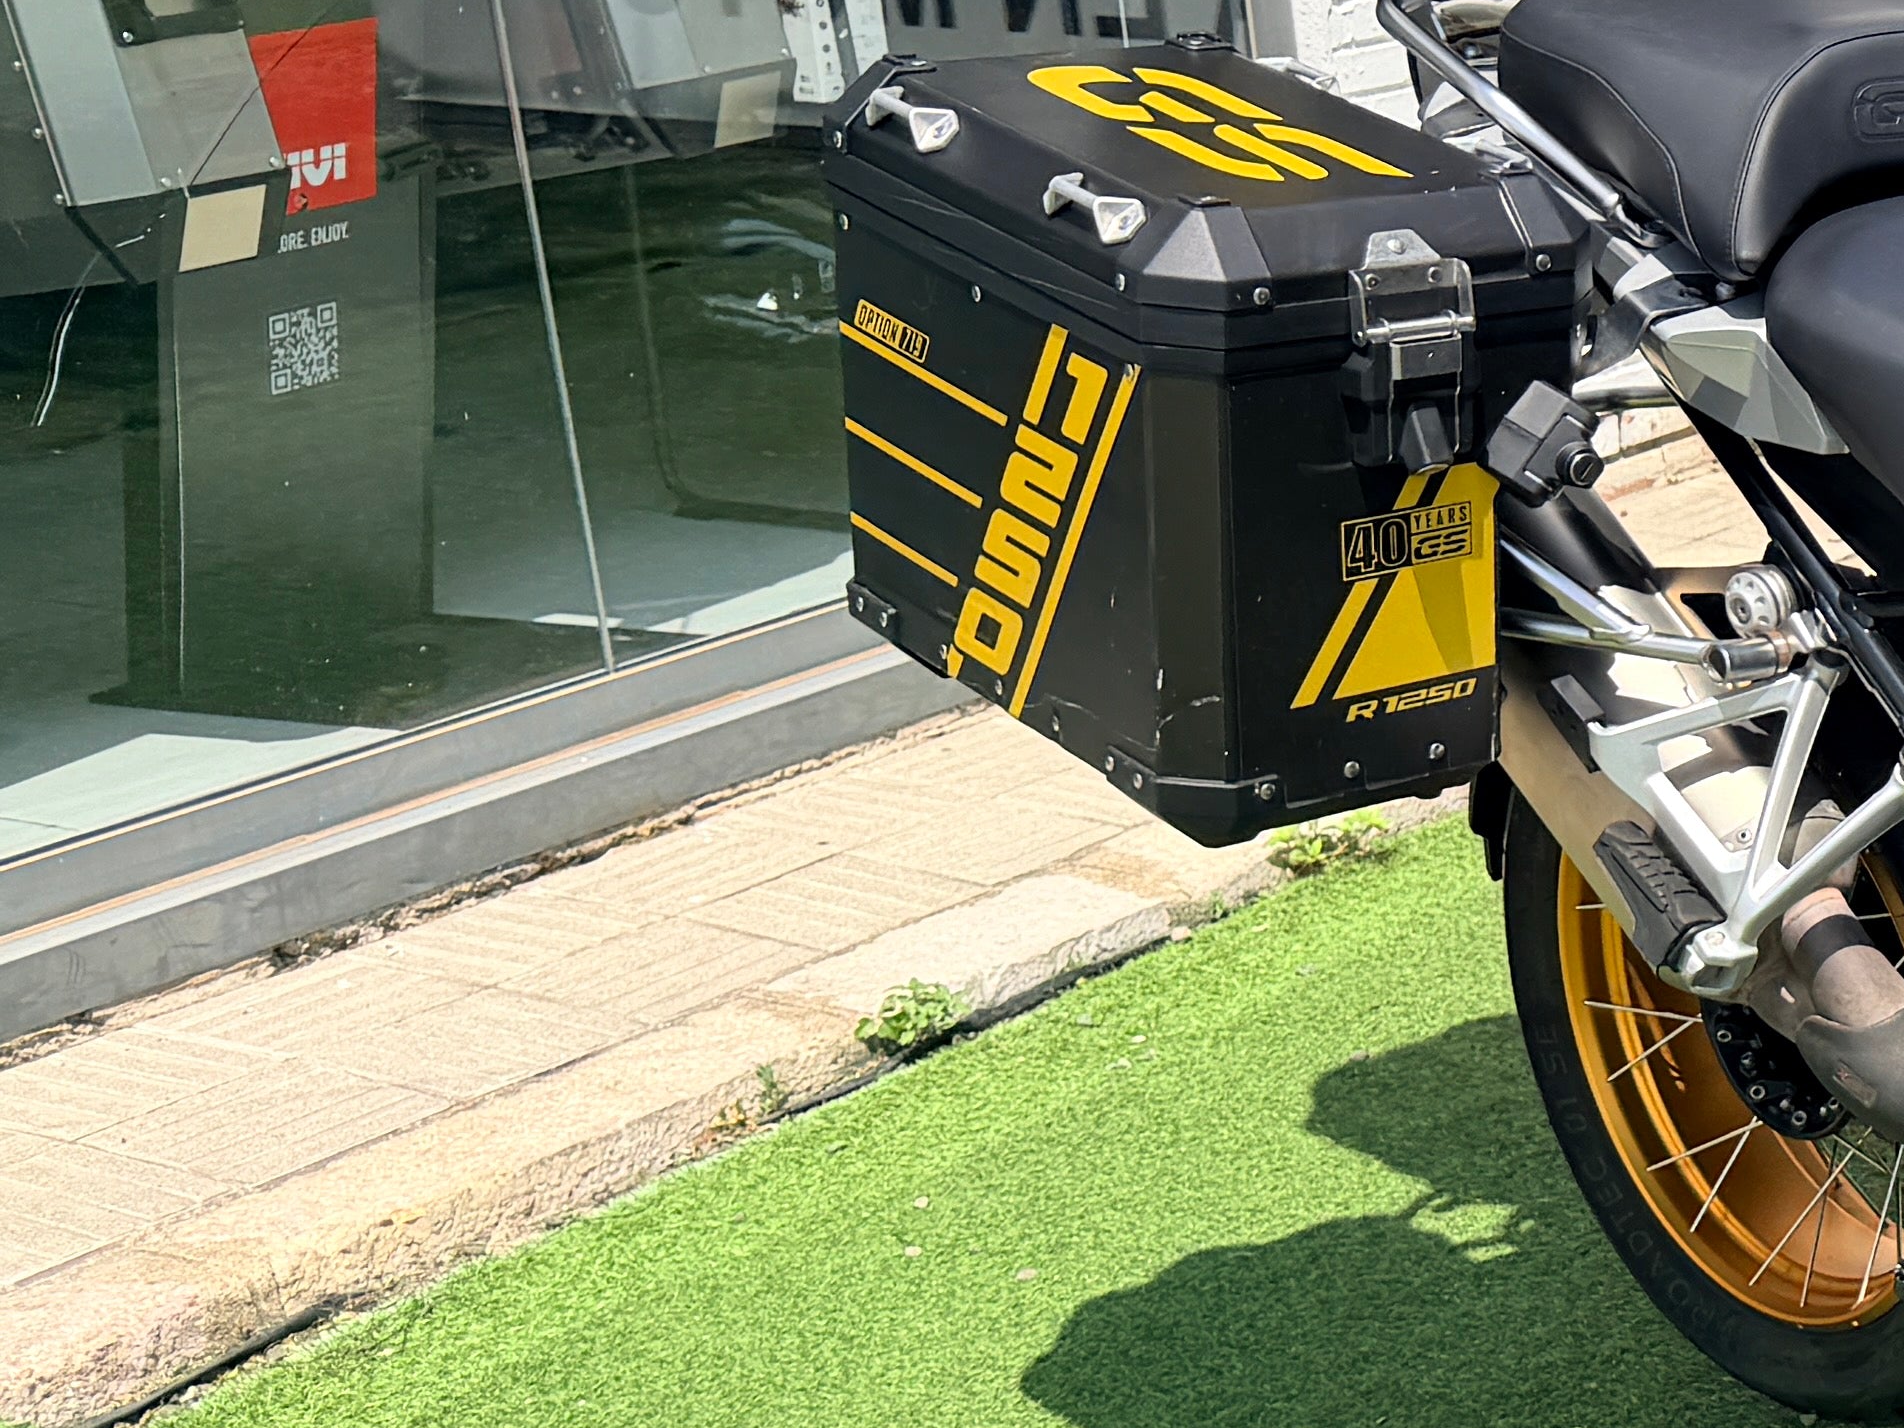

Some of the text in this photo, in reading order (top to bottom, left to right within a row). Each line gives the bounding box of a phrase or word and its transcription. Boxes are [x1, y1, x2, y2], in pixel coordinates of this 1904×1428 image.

[285, 143, 347, 190] IVI
[858, 303, 924, 357] OPTION 719
[1347, 505, 1468, 572] 40 YEARS
[1413, 528, 1469, 560] GS
[1345, 677, 1477, 723] R 1250
